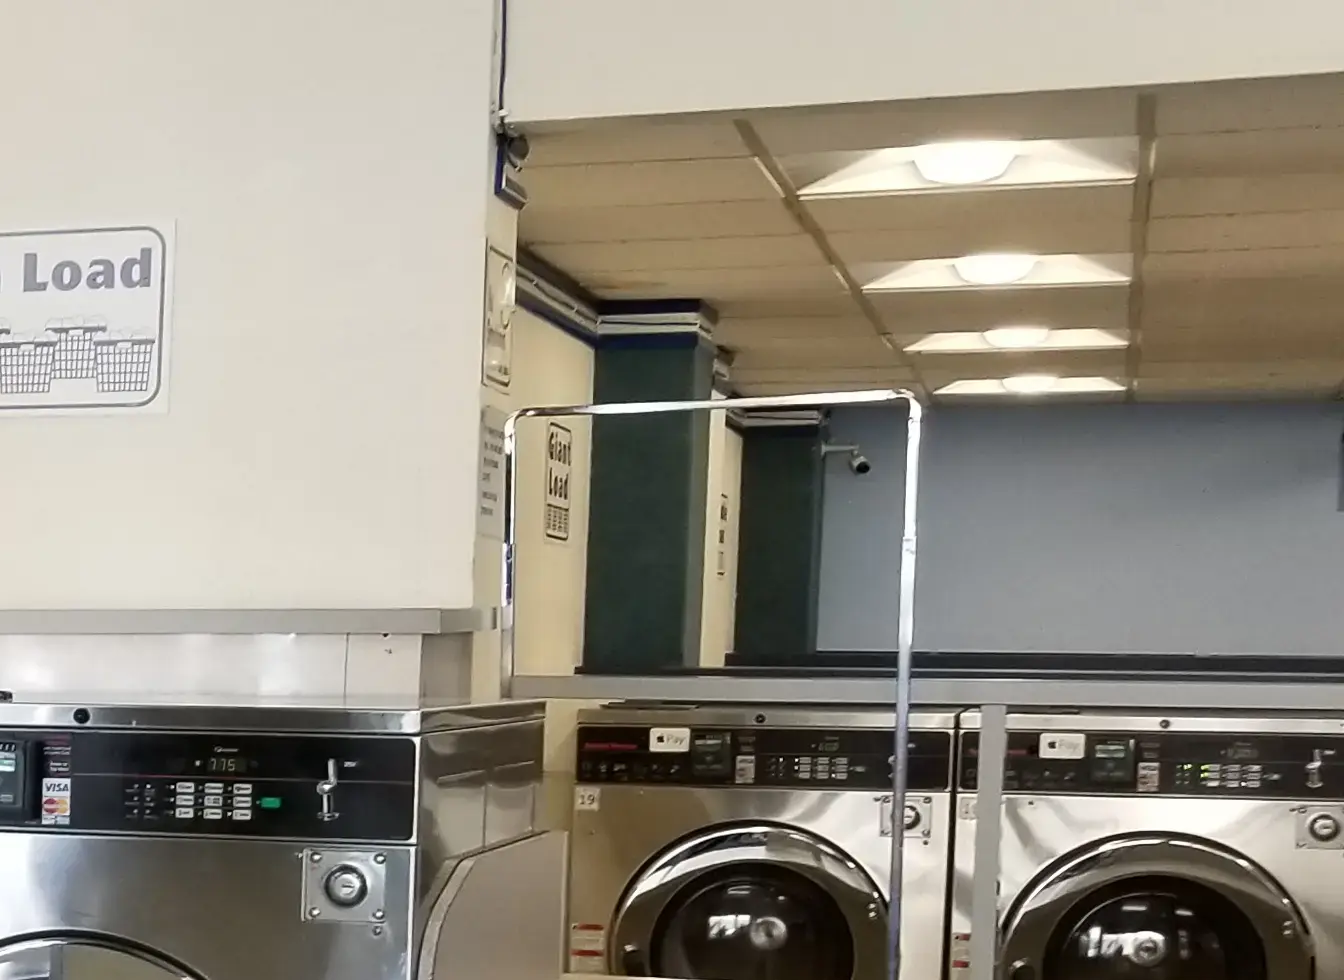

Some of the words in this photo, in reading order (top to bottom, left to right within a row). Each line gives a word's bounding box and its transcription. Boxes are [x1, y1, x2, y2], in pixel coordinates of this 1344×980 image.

[23, 247, 152, 292] Load
[549, 432, 571, 466] Giant
[549, 467, 569, 500] Load
[666, 734, 688, 746] Pay
[45, 782, 69, 793] VISA
[579, 793, 595, 806] 19
